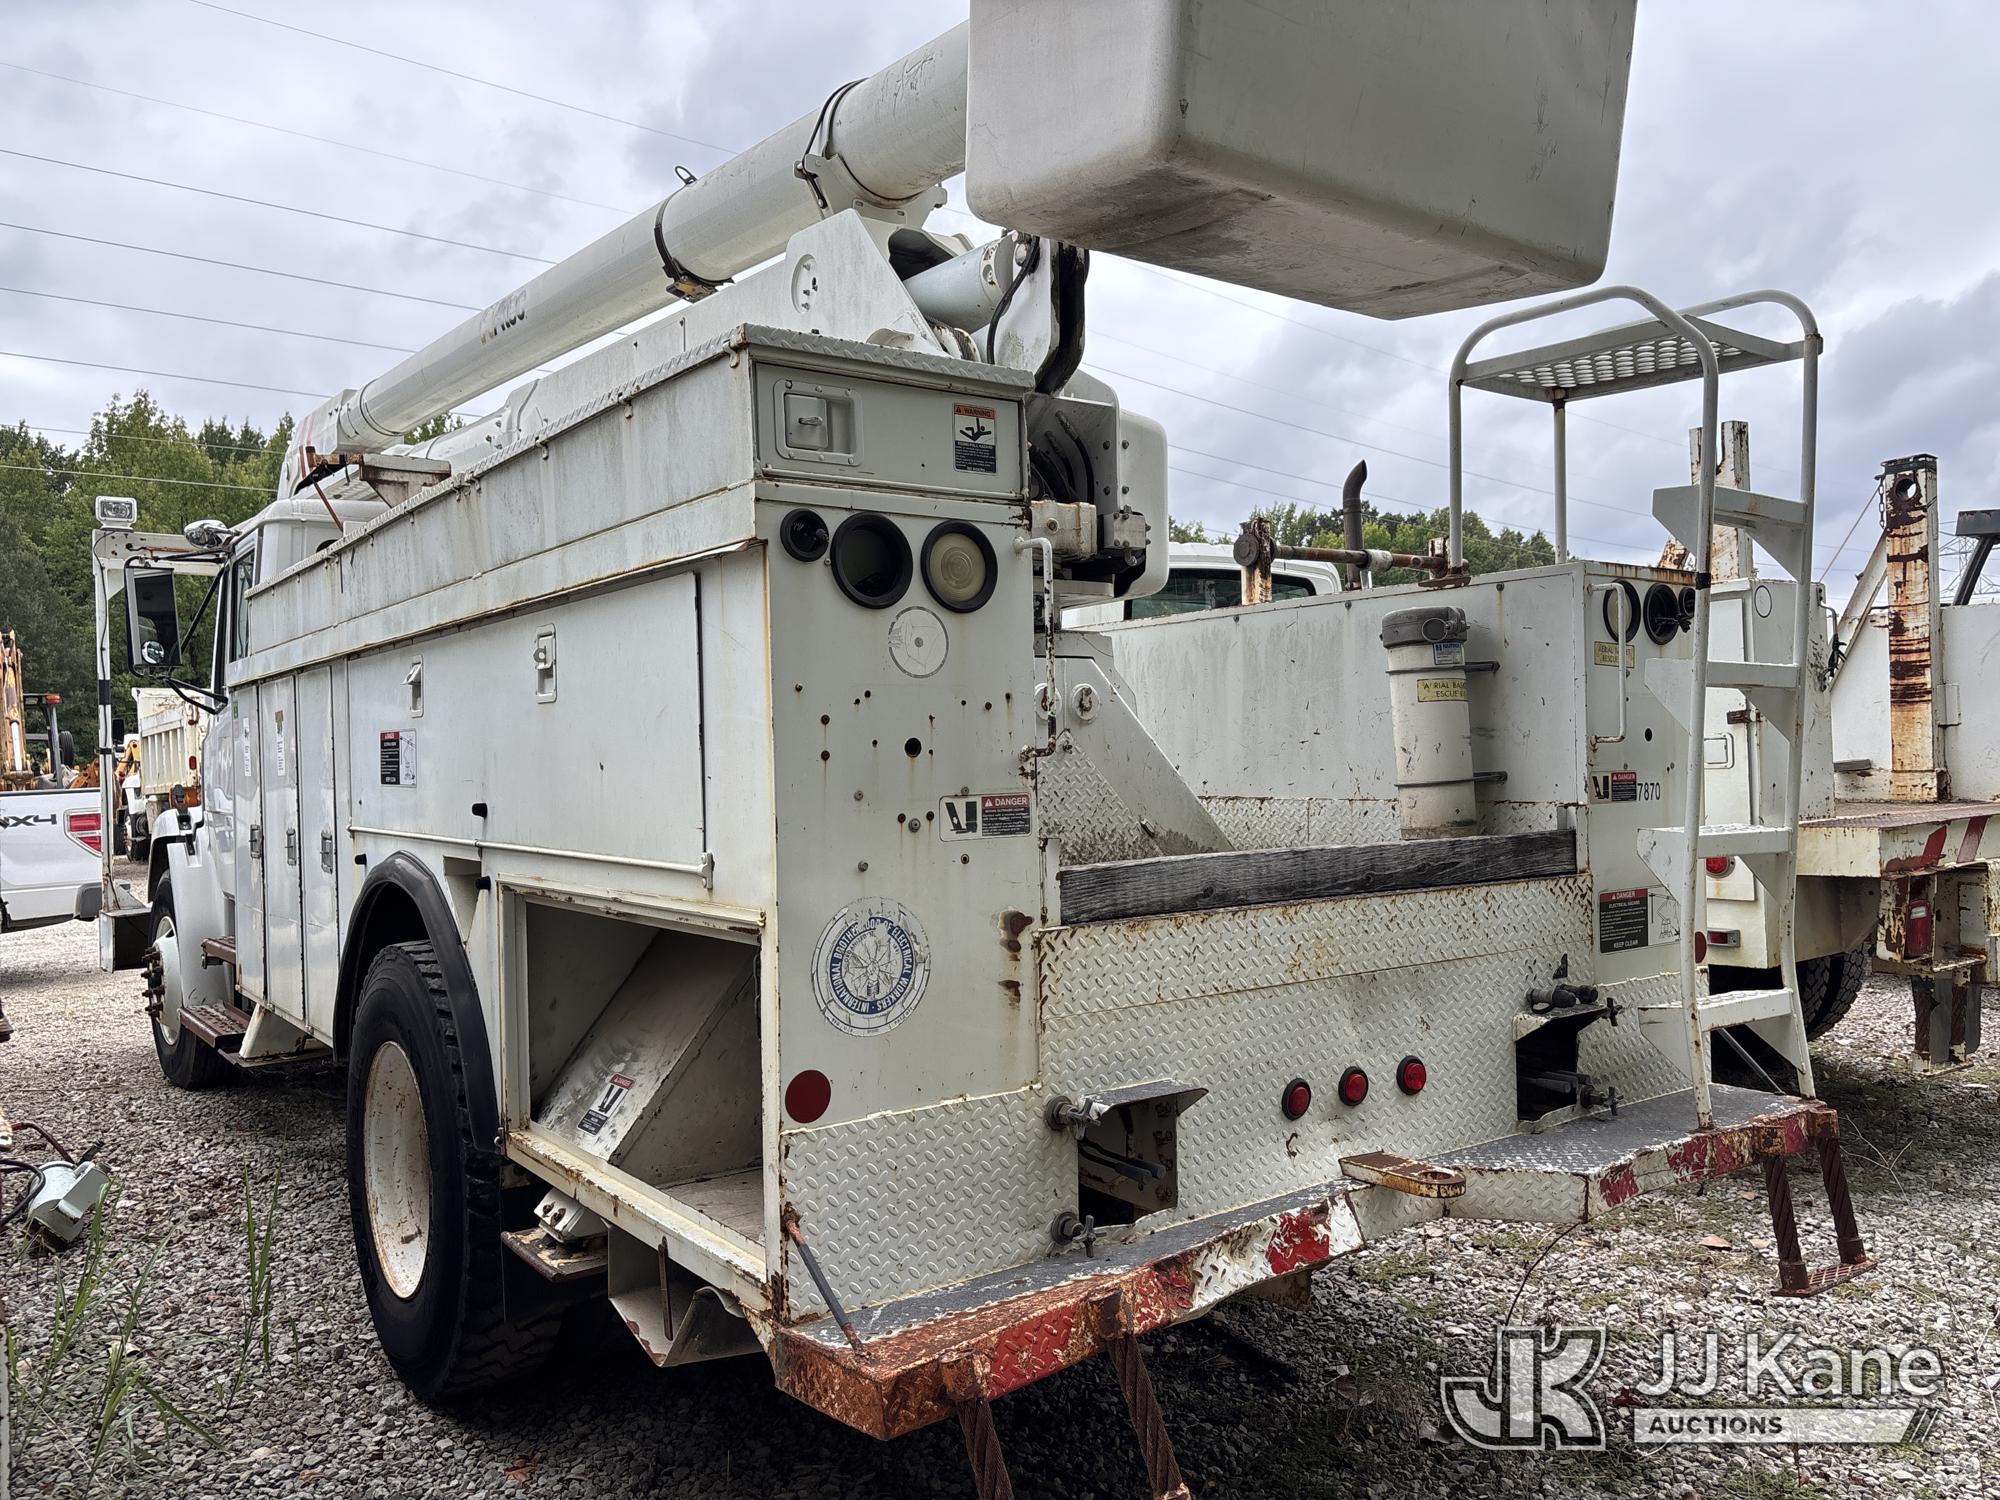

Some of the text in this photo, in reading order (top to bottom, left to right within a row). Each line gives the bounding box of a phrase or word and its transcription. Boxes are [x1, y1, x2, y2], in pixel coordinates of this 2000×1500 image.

[963, 407, 991, 417] WARNING
[1424, 682, 1449, 690] ARIAL
[1432, 690, 1459, 698] ESCUE
[1637, 782, 1661, 801] 7870
[994, 797, 1028, 807] DANGER
[1616, 891, 1636, 900] DANGER
[891, 927, 913, 974] ELECTRICAL
[831, 961, 870, 1013] INTERNATIONAL
[876, 976, 909, 1011] WORKERS
